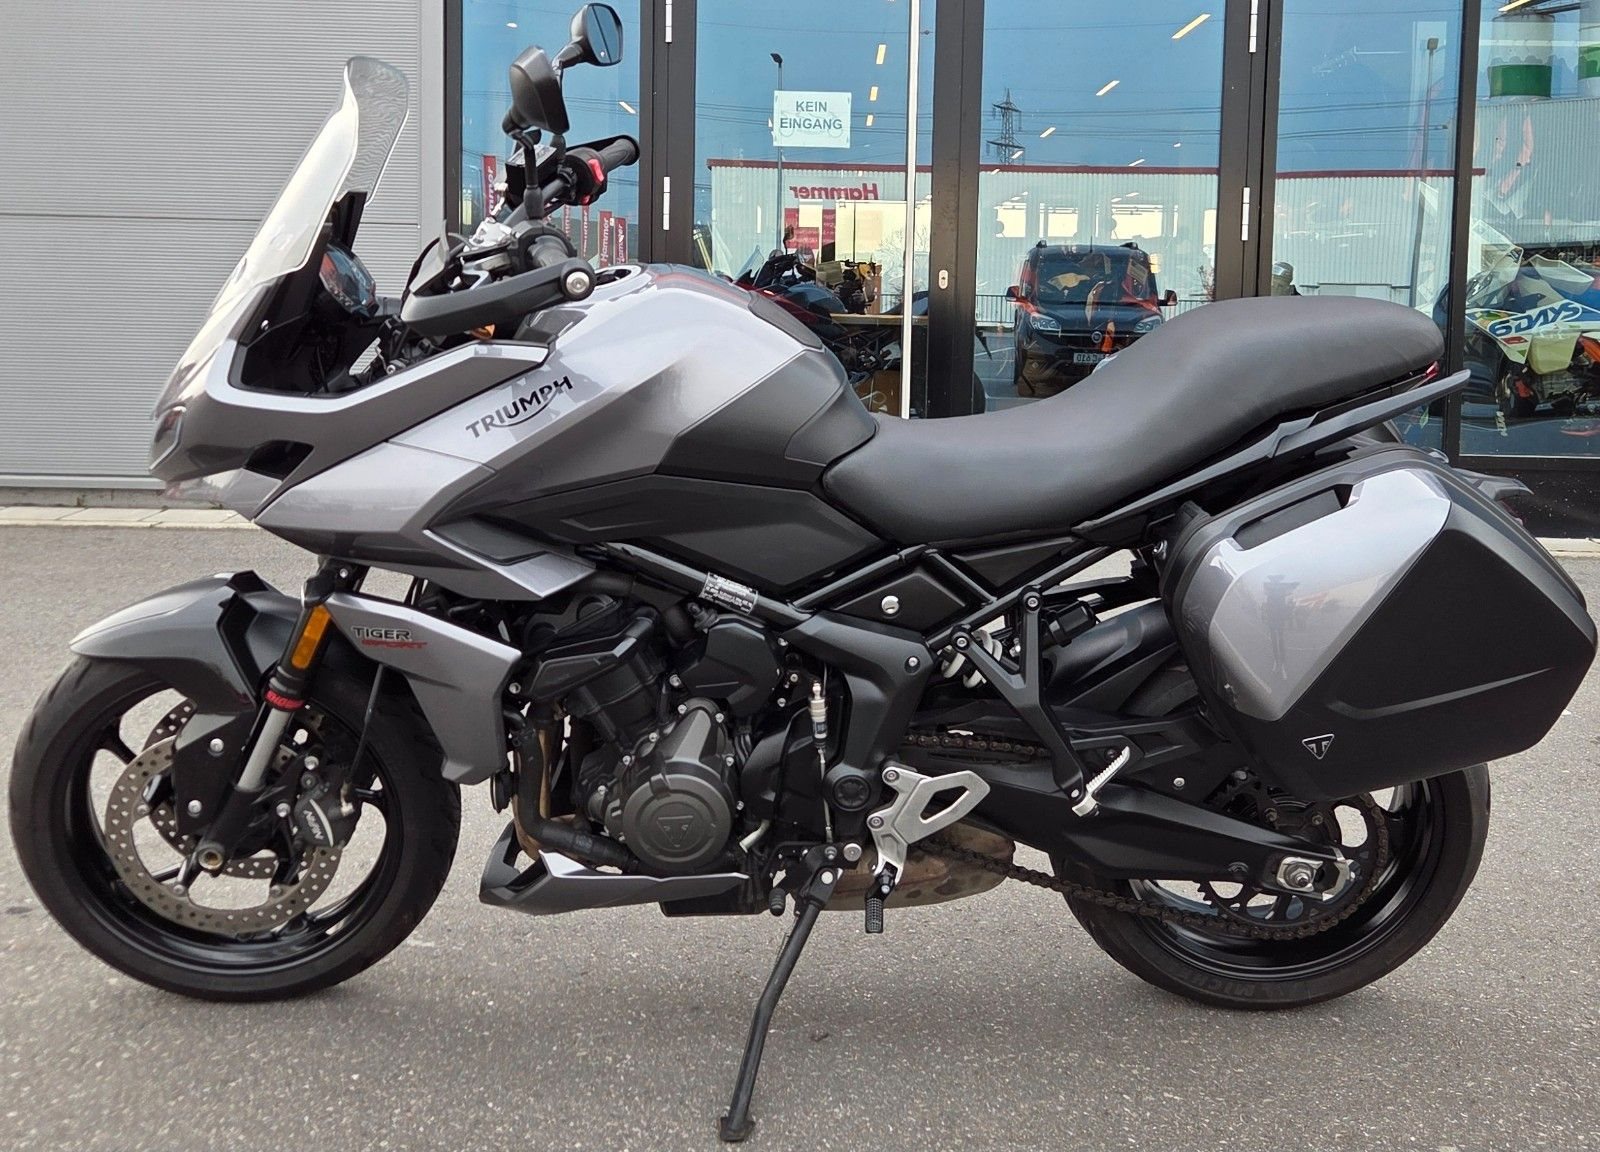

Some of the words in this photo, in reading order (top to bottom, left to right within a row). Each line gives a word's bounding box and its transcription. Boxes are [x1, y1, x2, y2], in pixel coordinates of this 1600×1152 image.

[796, 101, 827, 112] KEIN
[780, 118, 842, 130] EINGANG
[465, 376, 573, 438] TRIUMPH
[352, 626, 413, 641] TIGER
